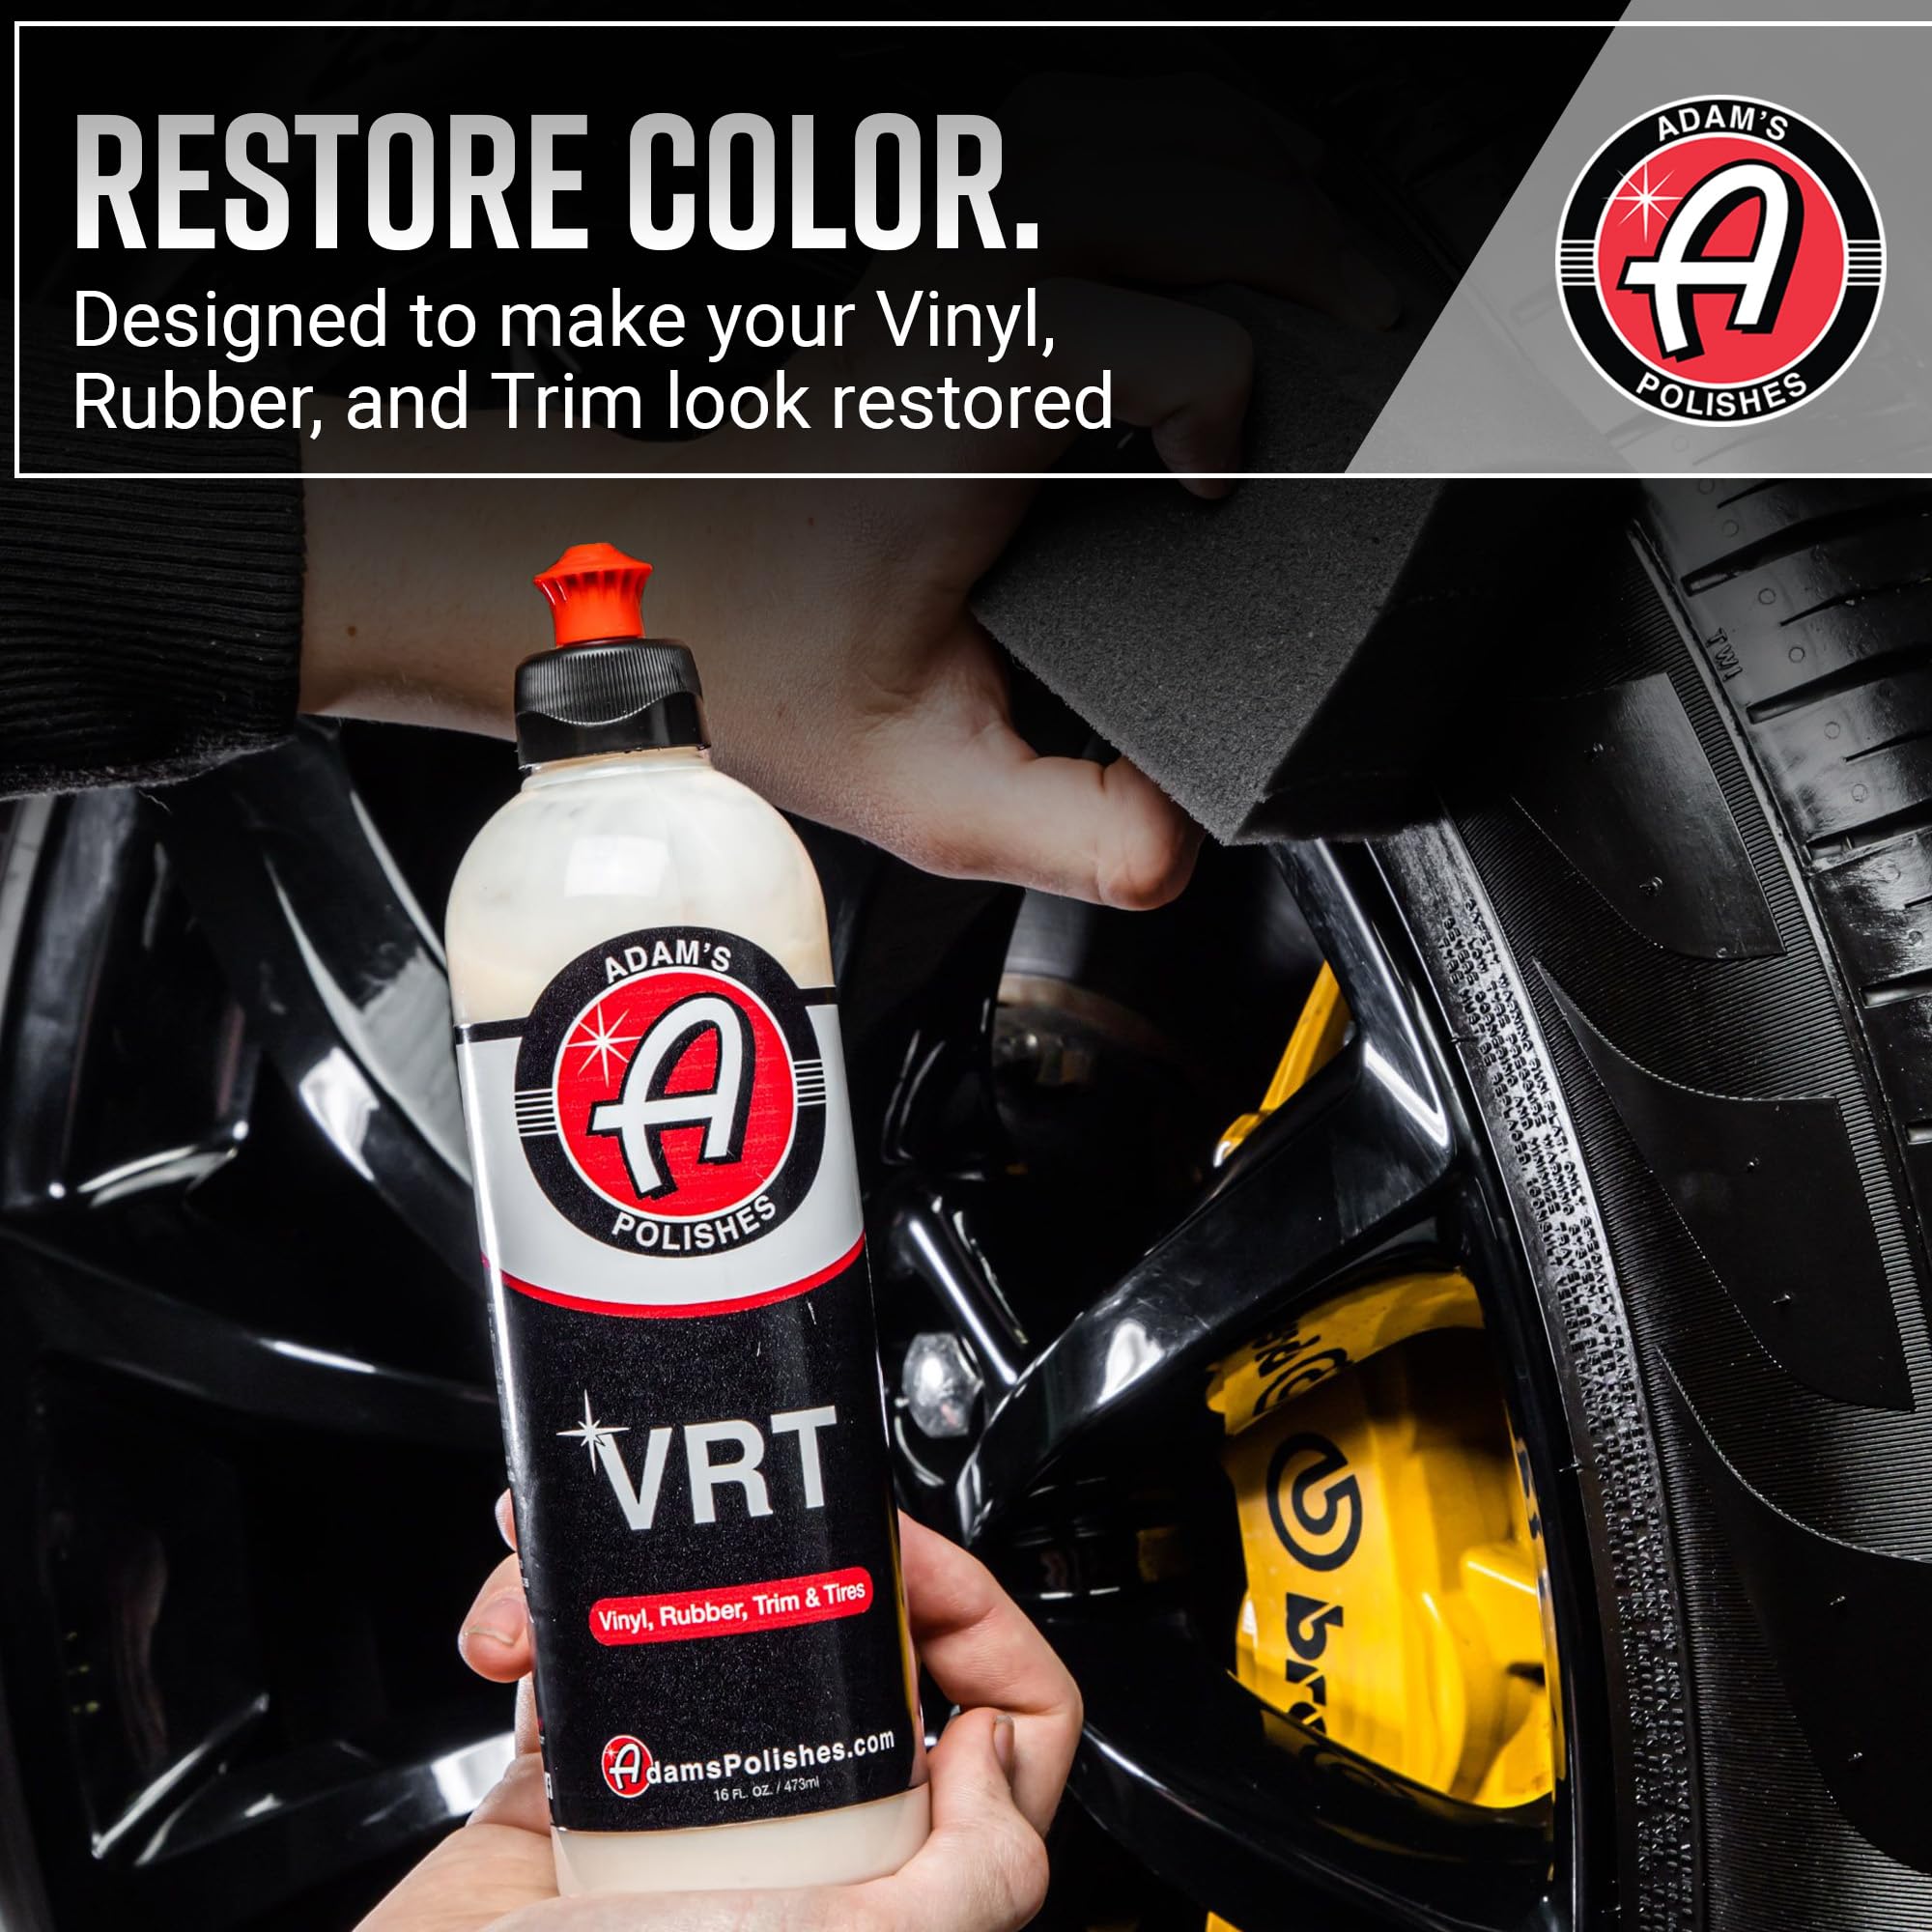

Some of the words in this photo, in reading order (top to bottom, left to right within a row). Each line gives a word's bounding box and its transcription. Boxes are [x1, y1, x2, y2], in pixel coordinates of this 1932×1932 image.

[605, 939, 731, 984] ADAM'S
[1503, 1033, 1547, 1128] PRESSURE
[1539, 1133, 1575, 1215] WARNING
[611, 1195, 777, 1251] POLISHES
[593, 1405, 837, 1531] VRT
[598, 1608, 654, 1635] Vinyl,
[661, 1600, 749, 1629] Rubber,
[753, 1592, 800, 1616] Trim
[805, 1589, 821, 1608] &
[823, 1581, 866, 1605] Tires
[713, 1787, 729, 1803] 16
